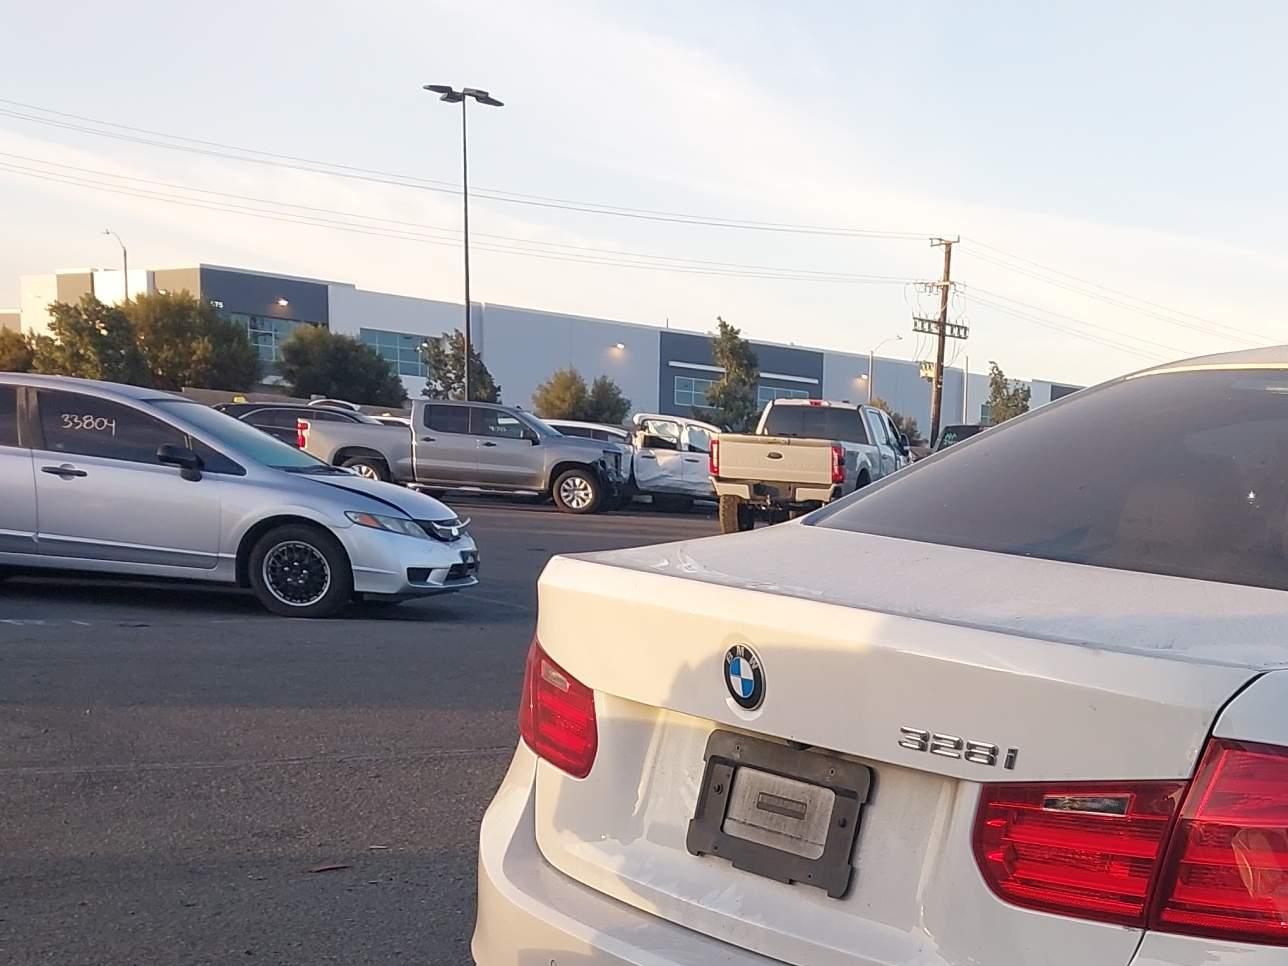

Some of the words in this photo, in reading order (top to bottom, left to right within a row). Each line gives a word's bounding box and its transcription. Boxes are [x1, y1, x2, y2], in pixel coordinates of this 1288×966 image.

[61, 413, 116, 437] 33804
[726, 644, 760, 670] BMW
[898, 726, 1019, 770] 328i
